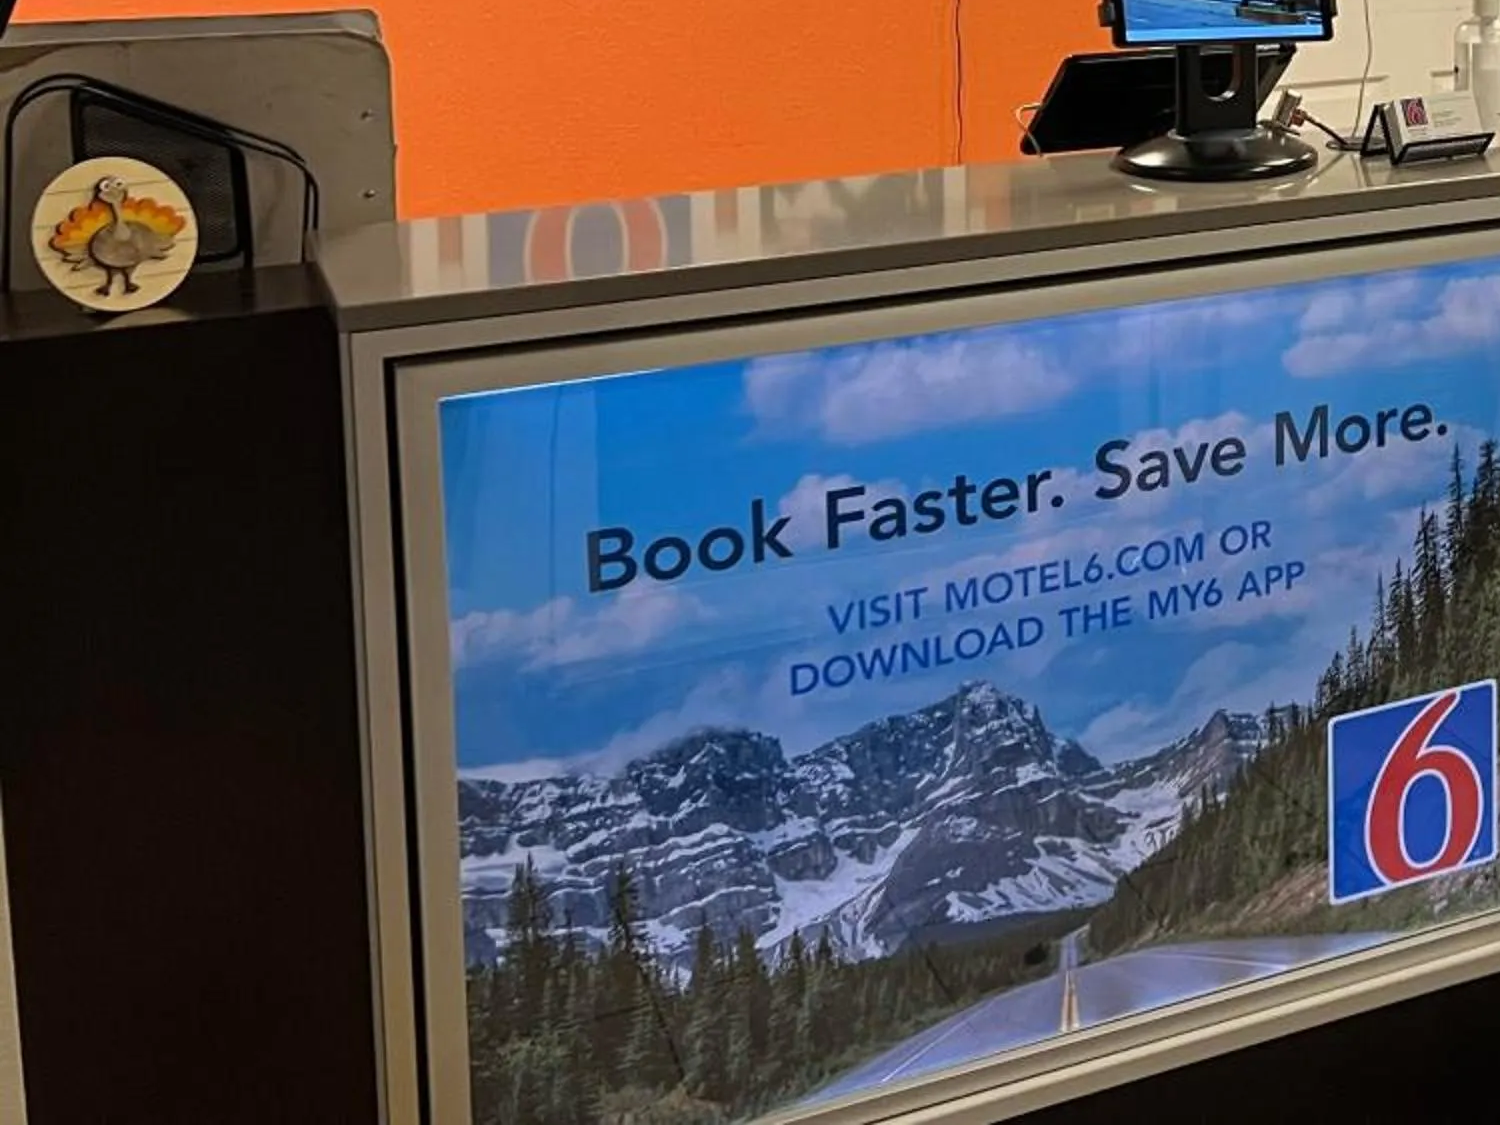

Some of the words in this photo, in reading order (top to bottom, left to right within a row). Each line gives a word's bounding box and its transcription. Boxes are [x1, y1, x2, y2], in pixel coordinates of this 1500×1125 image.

[587, 498, 793, 593] Book
[826, 469, 1065, 549] Faster.
[1095, 436, 1246, 500] Save
[1275, 403, 1448, 466] More.
[828, 587, 928, 635] VISIT
[945, 532, 1204, 613] MOTEL6.COM
[1219, 520, 1272, 556] OR
[790, 617, 1044, 696] DOWNLOAD
[1059, 596, 1132, 638] THE
[1148, 578, 1223, 621] MY6
[1236, 560, 1305, 602] APP
[1364, 688, 1484, 887] 6
